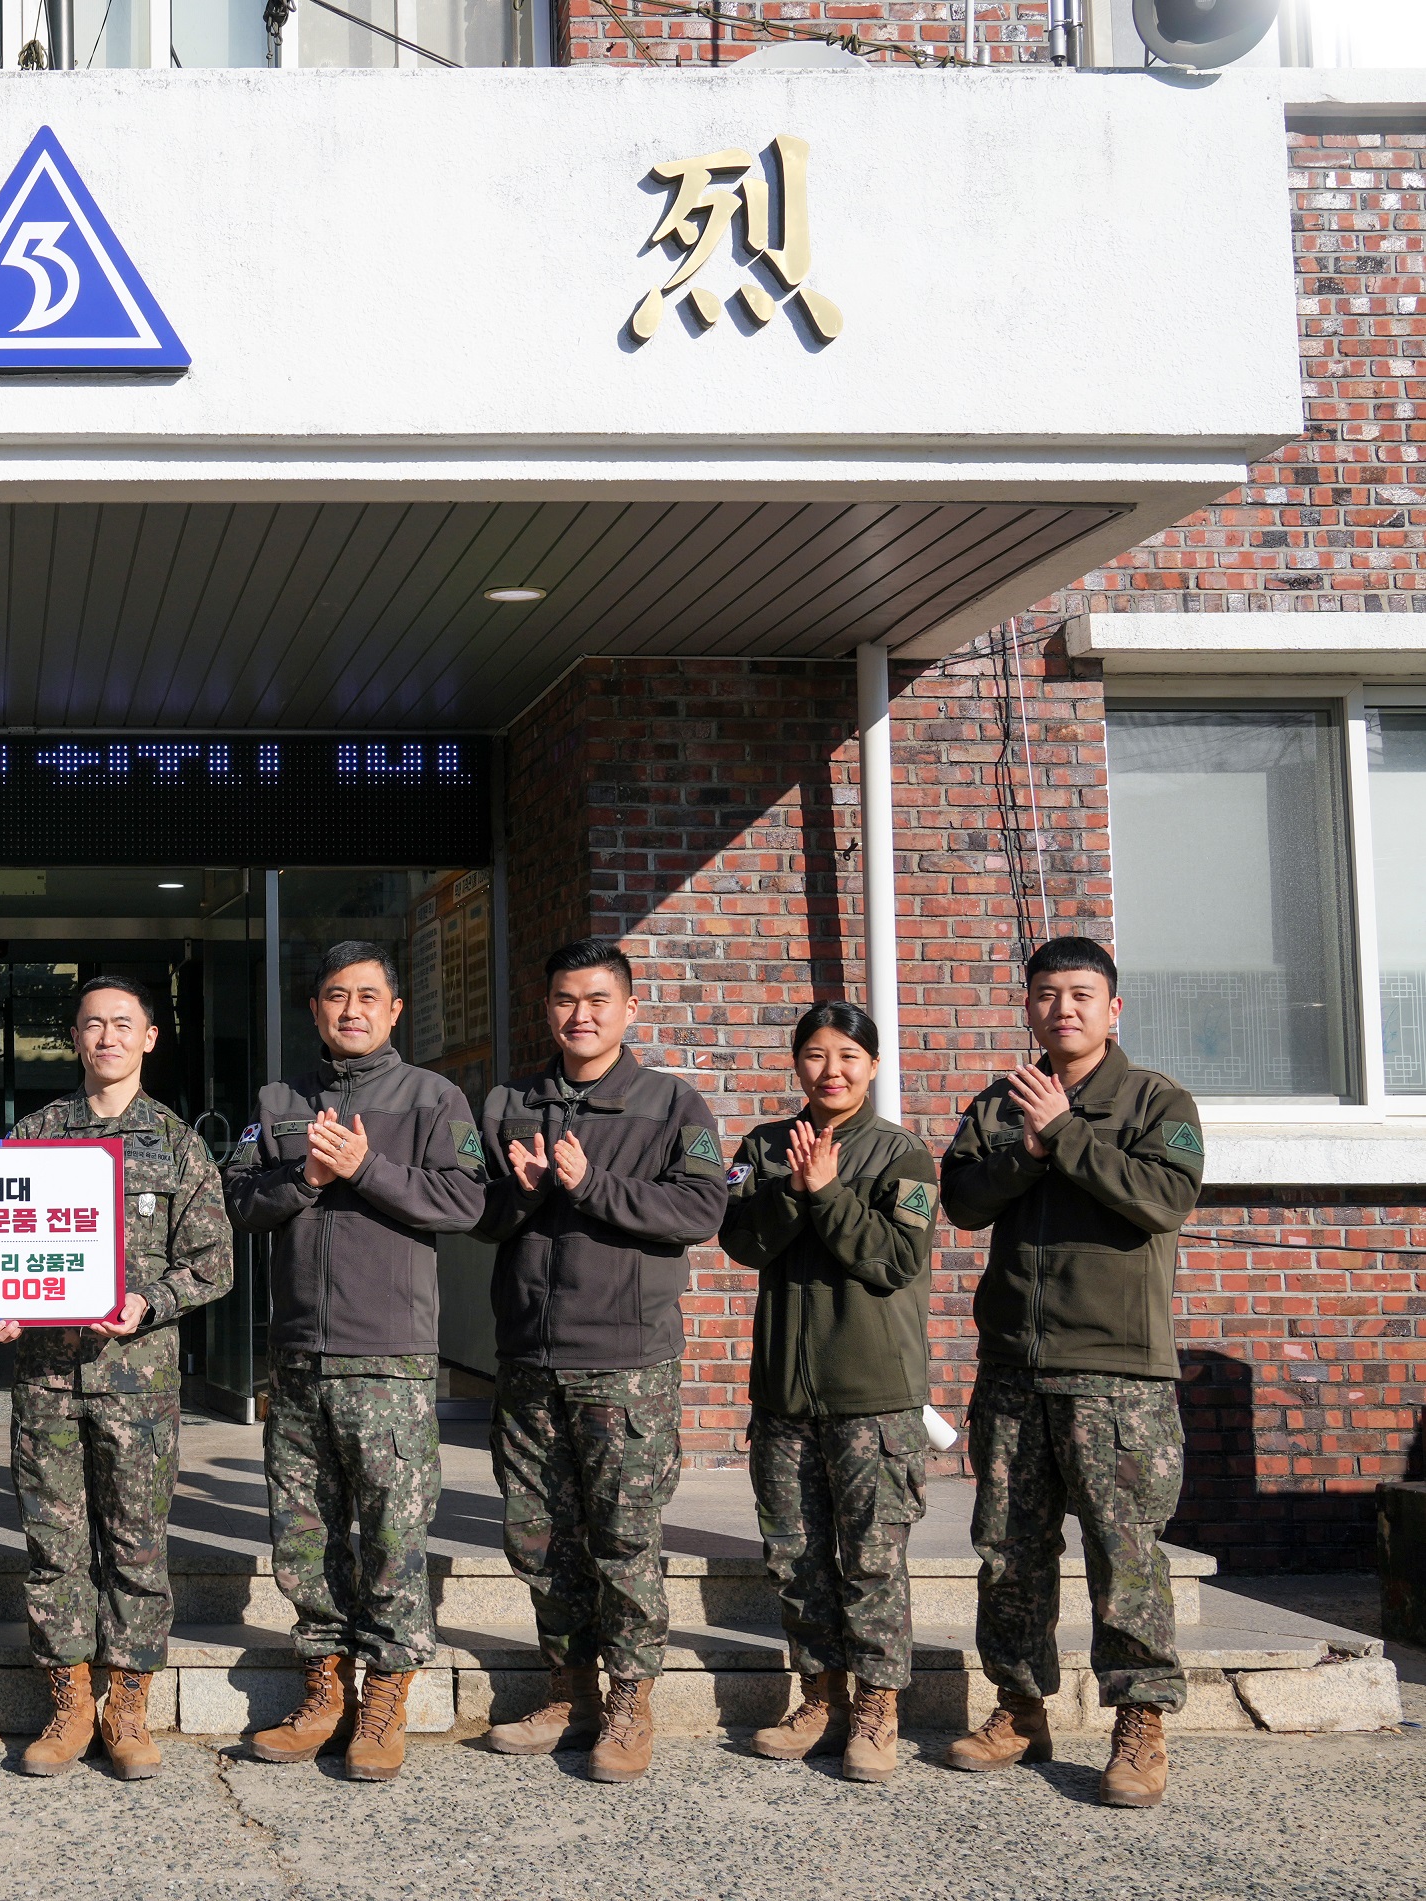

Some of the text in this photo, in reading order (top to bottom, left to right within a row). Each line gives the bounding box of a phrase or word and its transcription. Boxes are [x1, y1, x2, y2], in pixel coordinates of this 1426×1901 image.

[631, 133, 843, 345] 烈
[46, 1207, 100, 1233] 전달
[25, 1253, 85, 1273] 상품권
